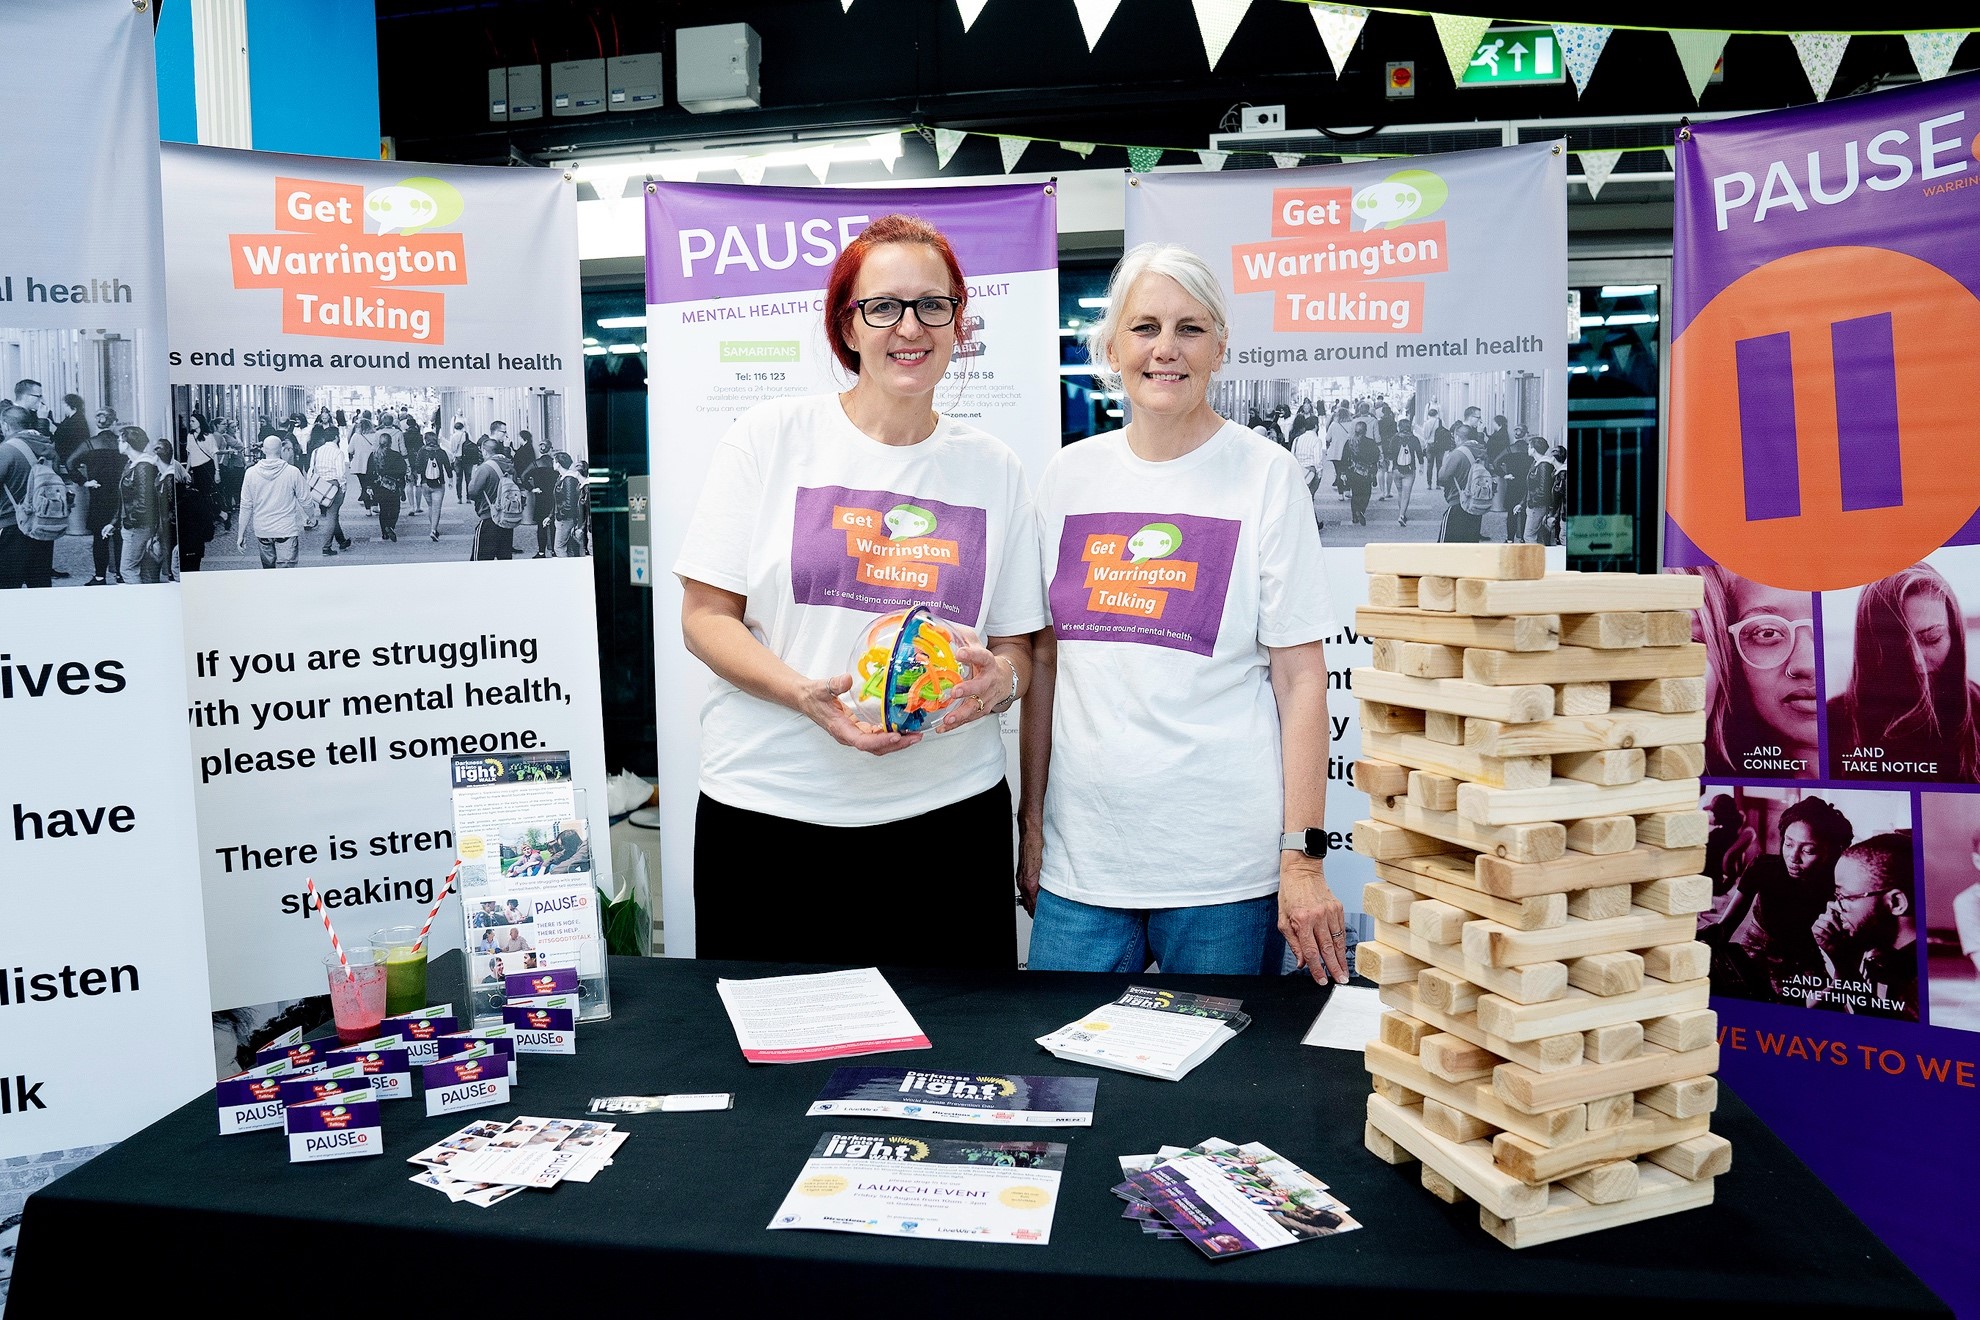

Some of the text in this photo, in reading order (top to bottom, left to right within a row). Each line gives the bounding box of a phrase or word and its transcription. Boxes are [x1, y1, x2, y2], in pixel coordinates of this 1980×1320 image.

[1713, 111, 1968, 231] PAUSE
[1922, 175, 1980, 197] WARRIN
[287, 192, 353, 224] Get
[1282, 200, 1340, 226] Get
[242, 243, 457, 281] Warrington
[1242, 237, 1438, 281] Warrington
[27, 276, 132, 303] health
[966, 283, 1010, 298] OLKIT
[296, 294, 430, 339] Talking
[682, 306, 745, 323] MENTAL
[750, 301, 808, 317] HEALTH
[1286, 292, 1409, 328] Talking
[190, 349, 235, 367] end
[243, 349, 323, 372] stigma
[330, 351, 411, 369] around
[418, 352, 490, 370] mental
[498, 353, 562, 371] health
[724, 346, 796, 357] SAMARITANS
[1238, 347, 1308, 367] stigma
[1314, 341, 1388, 361] around
[1396, 338, 1468, 359] mental
[1476, 334, 1544, 354] health
[736, 373, 785, 381] Tel: 116 123
[843, 512, 873, 528] Get
[856, 538, 950, 559] Warrington
[1091, 541, 1116, 555] Get
[865, 563, 928, 587] Talking
[1094, 566, 1187, 584] Warrington
[824, 588, 960, 613] let's end stigma around mental health
[1099, 591, 1156, 614] Talking
[1086, 623, 1111, 633] stigma
[1113, 625, 1136, 633] around
[1137, 626, 1165, 637] mental
[1166, 630, 1192, 642] health
[196, 634, 538, 682] If you are struggling
[0, 653, 127, 699] ives
[189, 677, 571, 730] ith your mental health,
[200, 729, 546, 783] please tell someone.
[1743, 746, 1782, 756] ...AND
[1842, 747, 1884, 758] ...AND
[455, 765, 497, 782] light
[1744, 759, 1807, 770] CONNECT
[1842, 761, 1937, 773] TAKE NOTICE
[13, 804, 136, 841] have
[216, 843, 317, 873] There
[330, 835, 357, 860] is
[369, 829, 453, 857] stren
[281, 876, 434, 919] speaking
[535, 895, 578, 914] PAUSE
[0, 964, 140, 1006] listen
[1782, 975, 1872, 993] ...AND LEARN
[1782, 986, 1905, 1011] SOMETHING NEW
[407, 1042, 437, 1057] AUSE
[517, 1033, 554, 1045] PAUSE
[1756, 1031, 1848, 1065] WAYS
[1858, 1045, 1905, 1074] TO
[899, 1076, 997, 1096] light
[907, 1071, 970, 1081] Darkness
[0, 1074, 47, 1114] lk
[442, 1083, 487, 1105] PAUSE
[236, 1103, 283, 1124] PAUSE
[307, 1132, 357, 1152] PAUSE
[823, 1139, 910, 1157] light
[858, 1184, 990, 1197] LAUNCH EVENT
